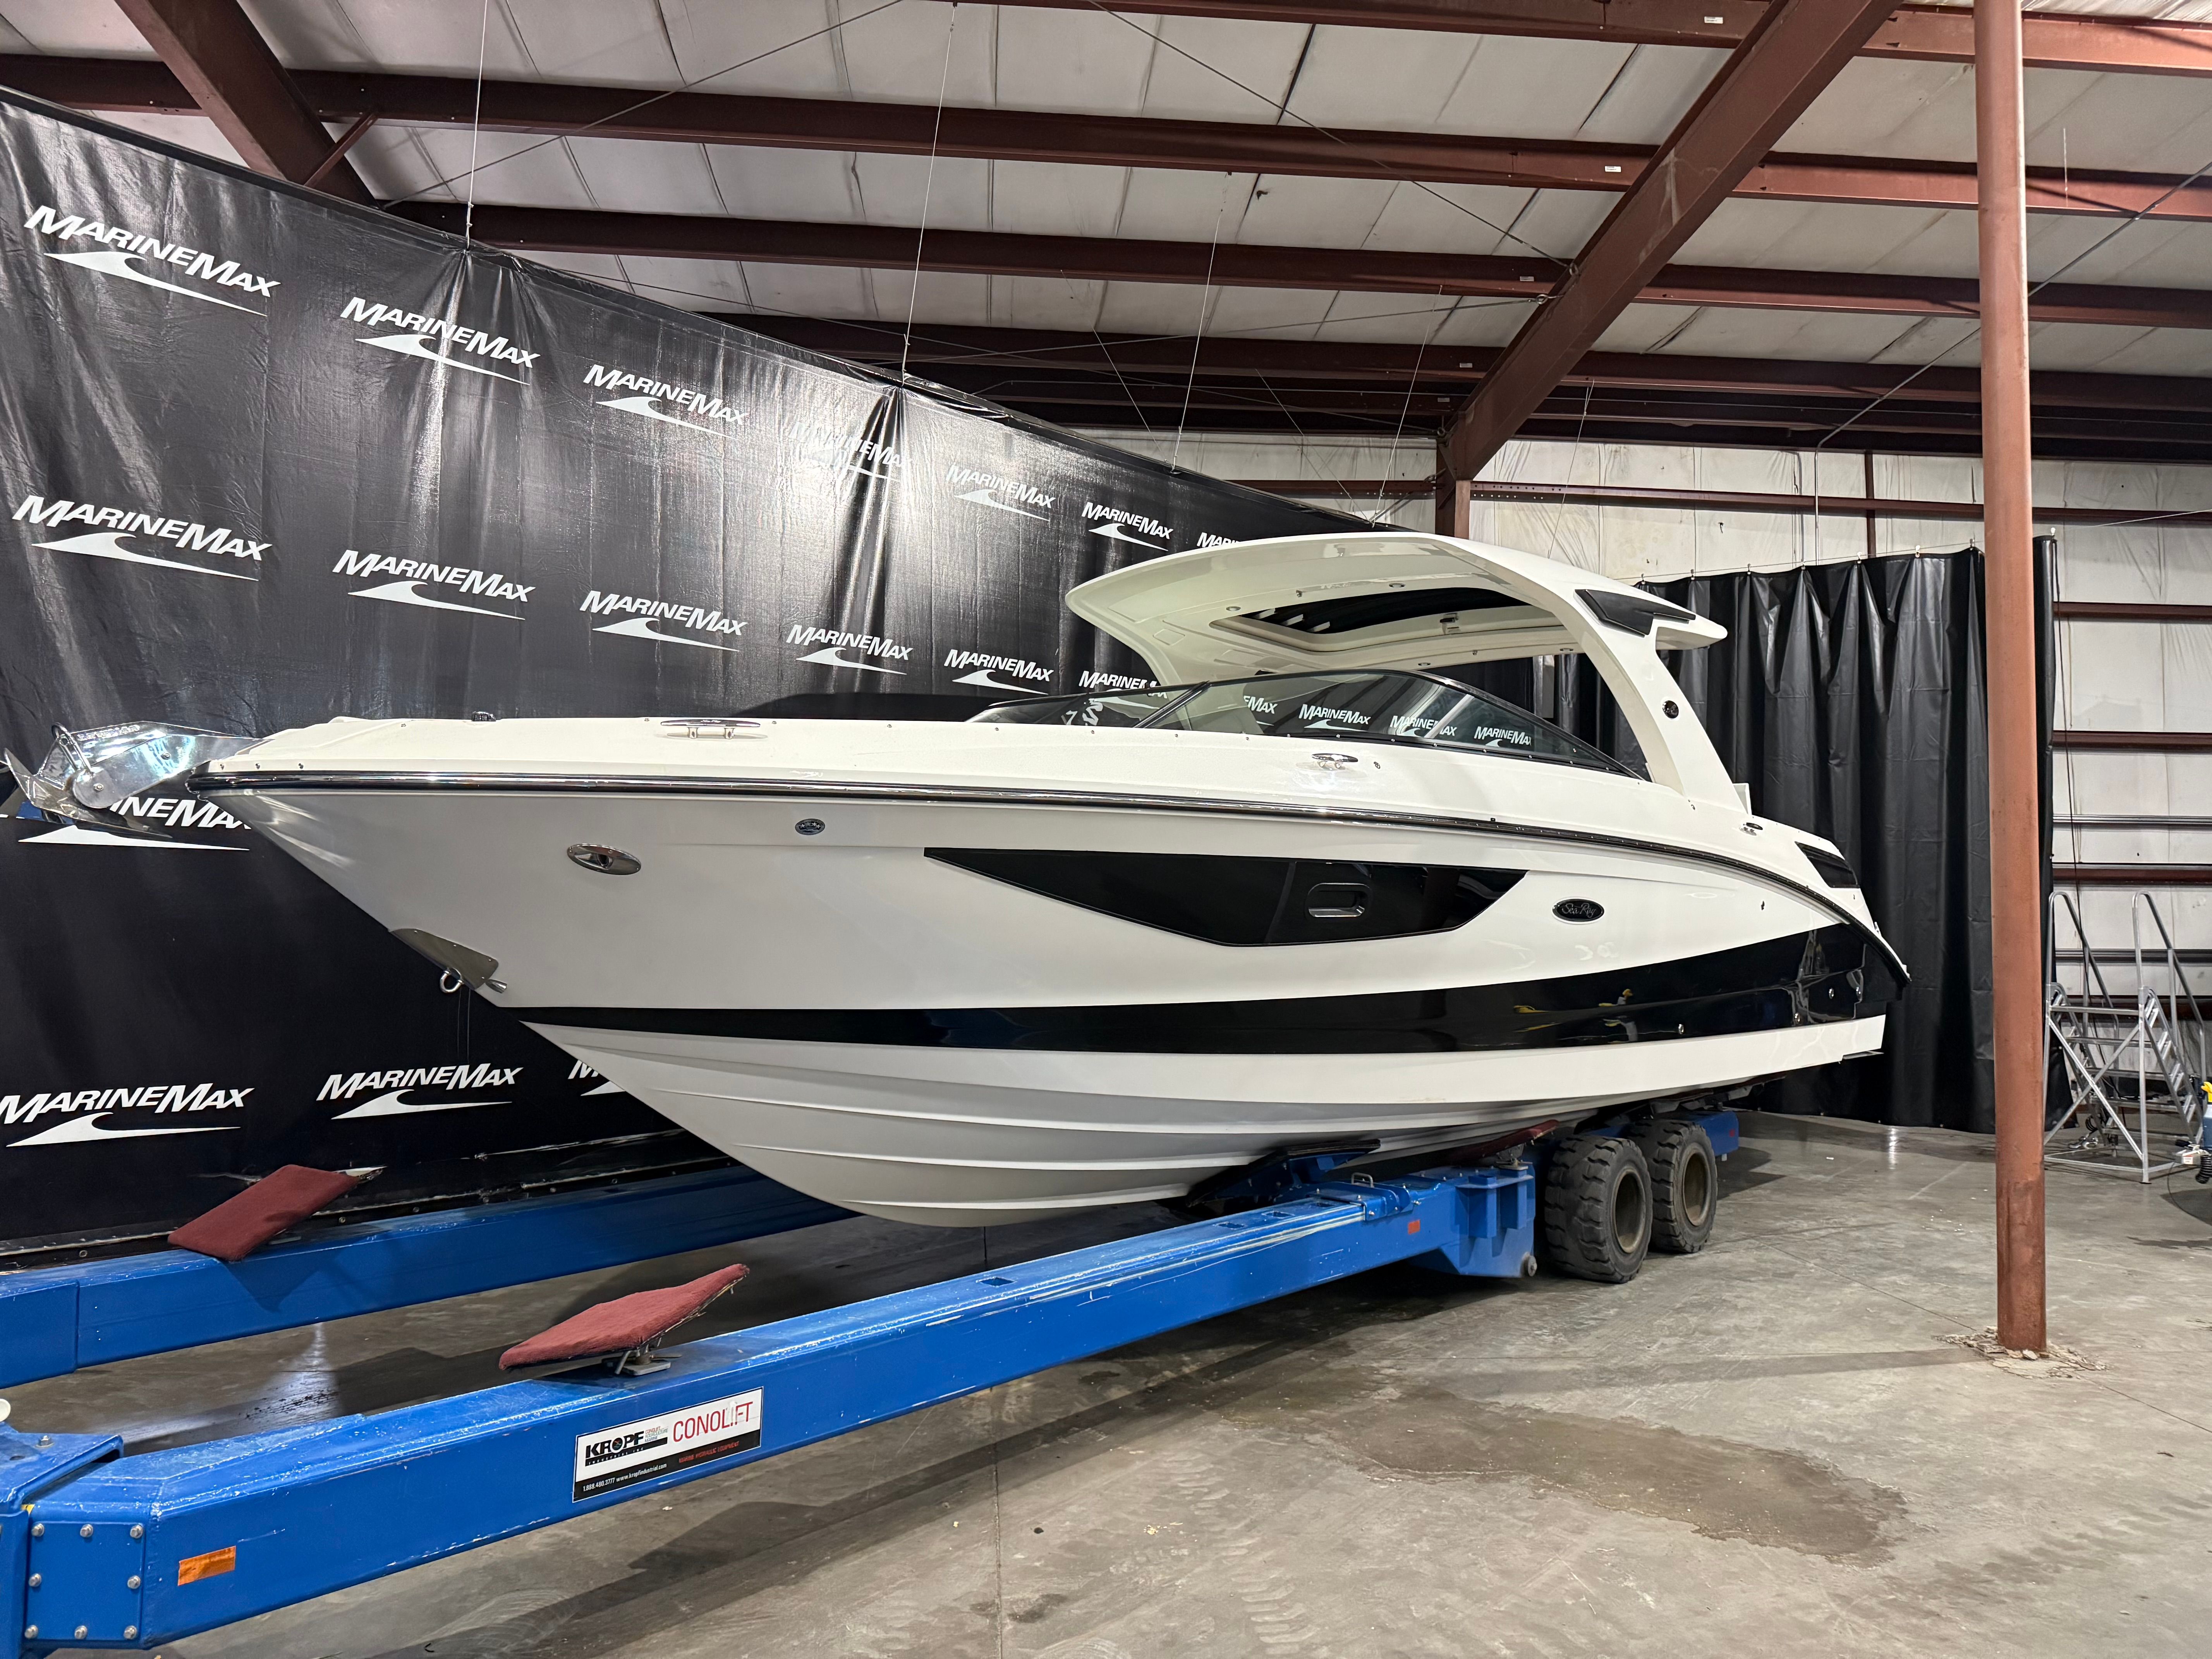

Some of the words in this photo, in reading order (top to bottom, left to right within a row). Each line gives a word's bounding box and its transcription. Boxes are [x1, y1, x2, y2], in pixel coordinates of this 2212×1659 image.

[24, 205, 281, 297] MARINEMAX
[340, 297, 541, 368] MARINEMAX
[583, 364, 750, 425] MARINEMAX
[12, 495, 272, 561] MARINEMAX
[1082, 502, 1173, 540] MARINEMAX
[333, 550, 536, 602] MARINEMAX
[580, 590, 748, 636] MARINEMAX
[786, 625, 914, 661] MARINEMAX
[944, 649, 1054, 682] MARINEMAX
[1390, 715, 1457, 736] MARINEAX
[1561, 903, 1579, 915] Sea
[1579, 903, 1596, 918] Ray
[316, 1063, 524, 1101] MARINEMAX
